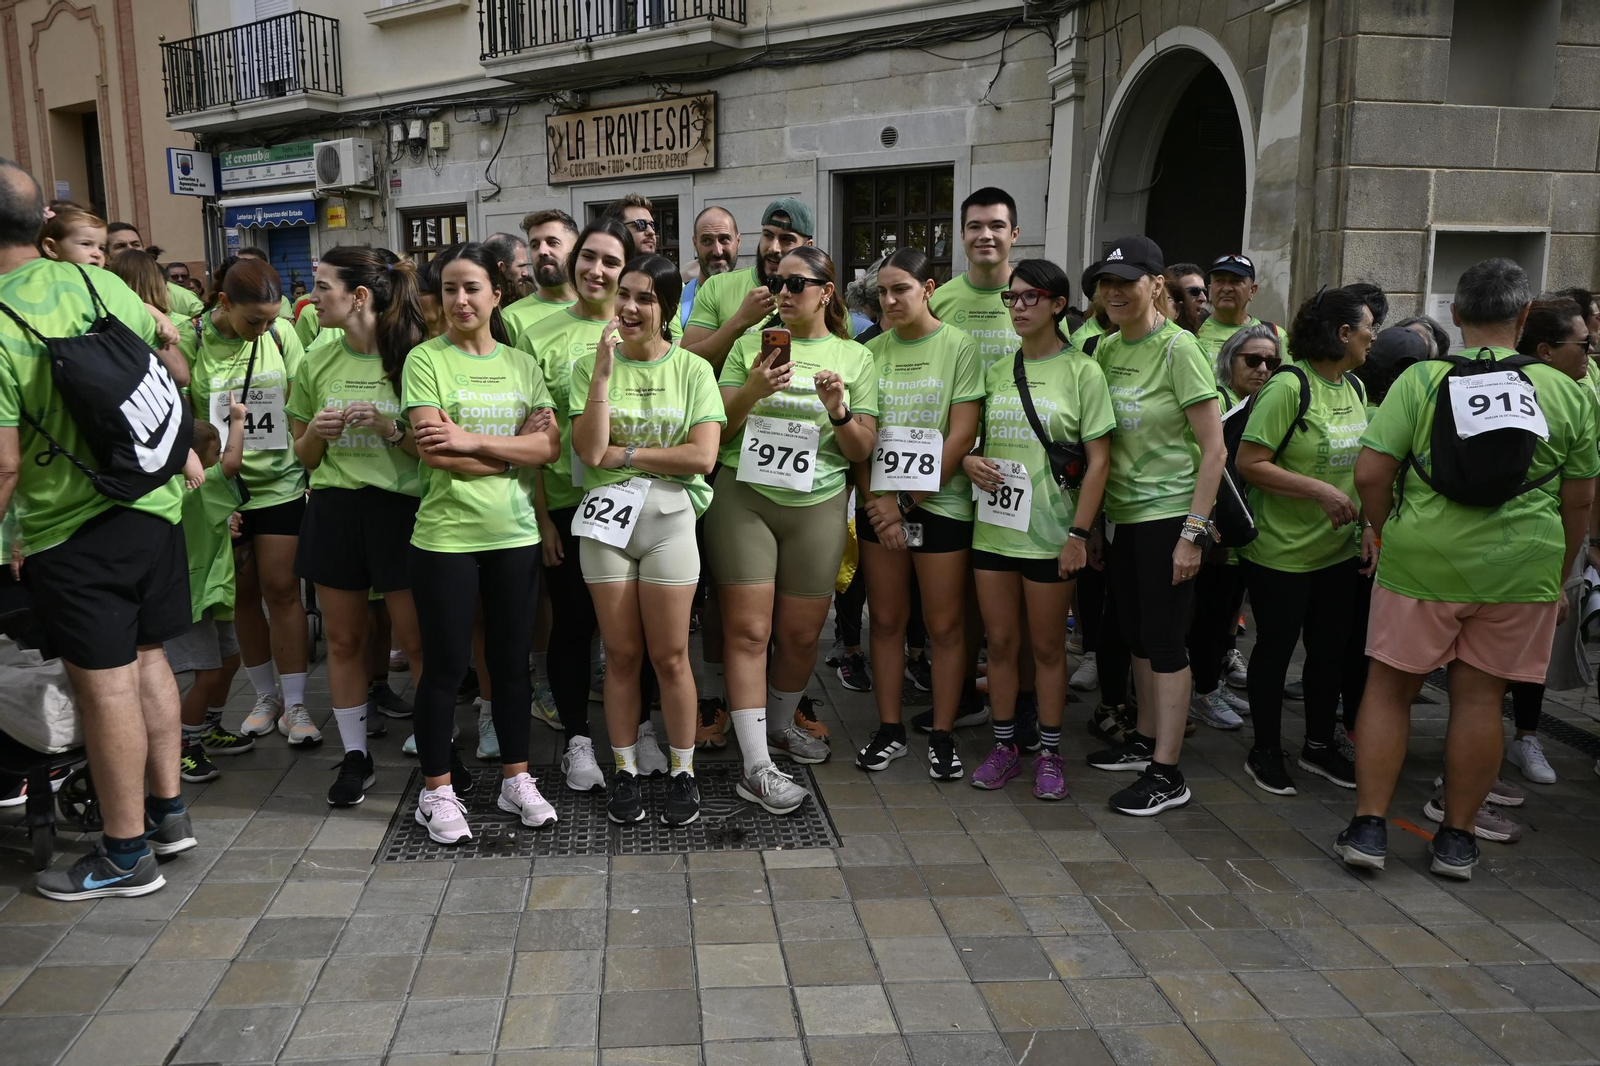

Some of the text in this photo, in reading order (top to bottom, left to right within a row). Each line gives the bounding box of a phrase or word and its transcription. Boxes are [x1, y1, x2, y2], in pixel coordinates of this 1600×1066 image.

[566, 104, 690, 160] LA TRAVIESA
[234, 149, 270, 164] cronub@
[570, 162, 602, 178] COCKTAIL
[608, 159, 624, 174] FOOD
[263, 211, 281, 220] Apuestas
[212, 378, 228, 389] En
[878, 376, 944, 390] En marcha
[120, 353, 172, 443] NIKE
[326, 397, 343, 408] En
[458, 389, 528, 402] En marcha
[760, 392, 825, 412] cánce
[878, 391, 941, 406] contra el
[992, 395, 1006, 404] En
[460, 404, 526, 418] contra el
[609, 404, 684, 419] En marcha
[1468, 392, 1536, 417] 915
[989, 408, 1026, 421] contr
[462, 419, 518, 436] cánce
[611, 421, 661, 435] contra
[990, 422, 1040, 442] cánce
[1330, 435, 1362, 449] cont
[1329, 450, 1359, 466] cán
